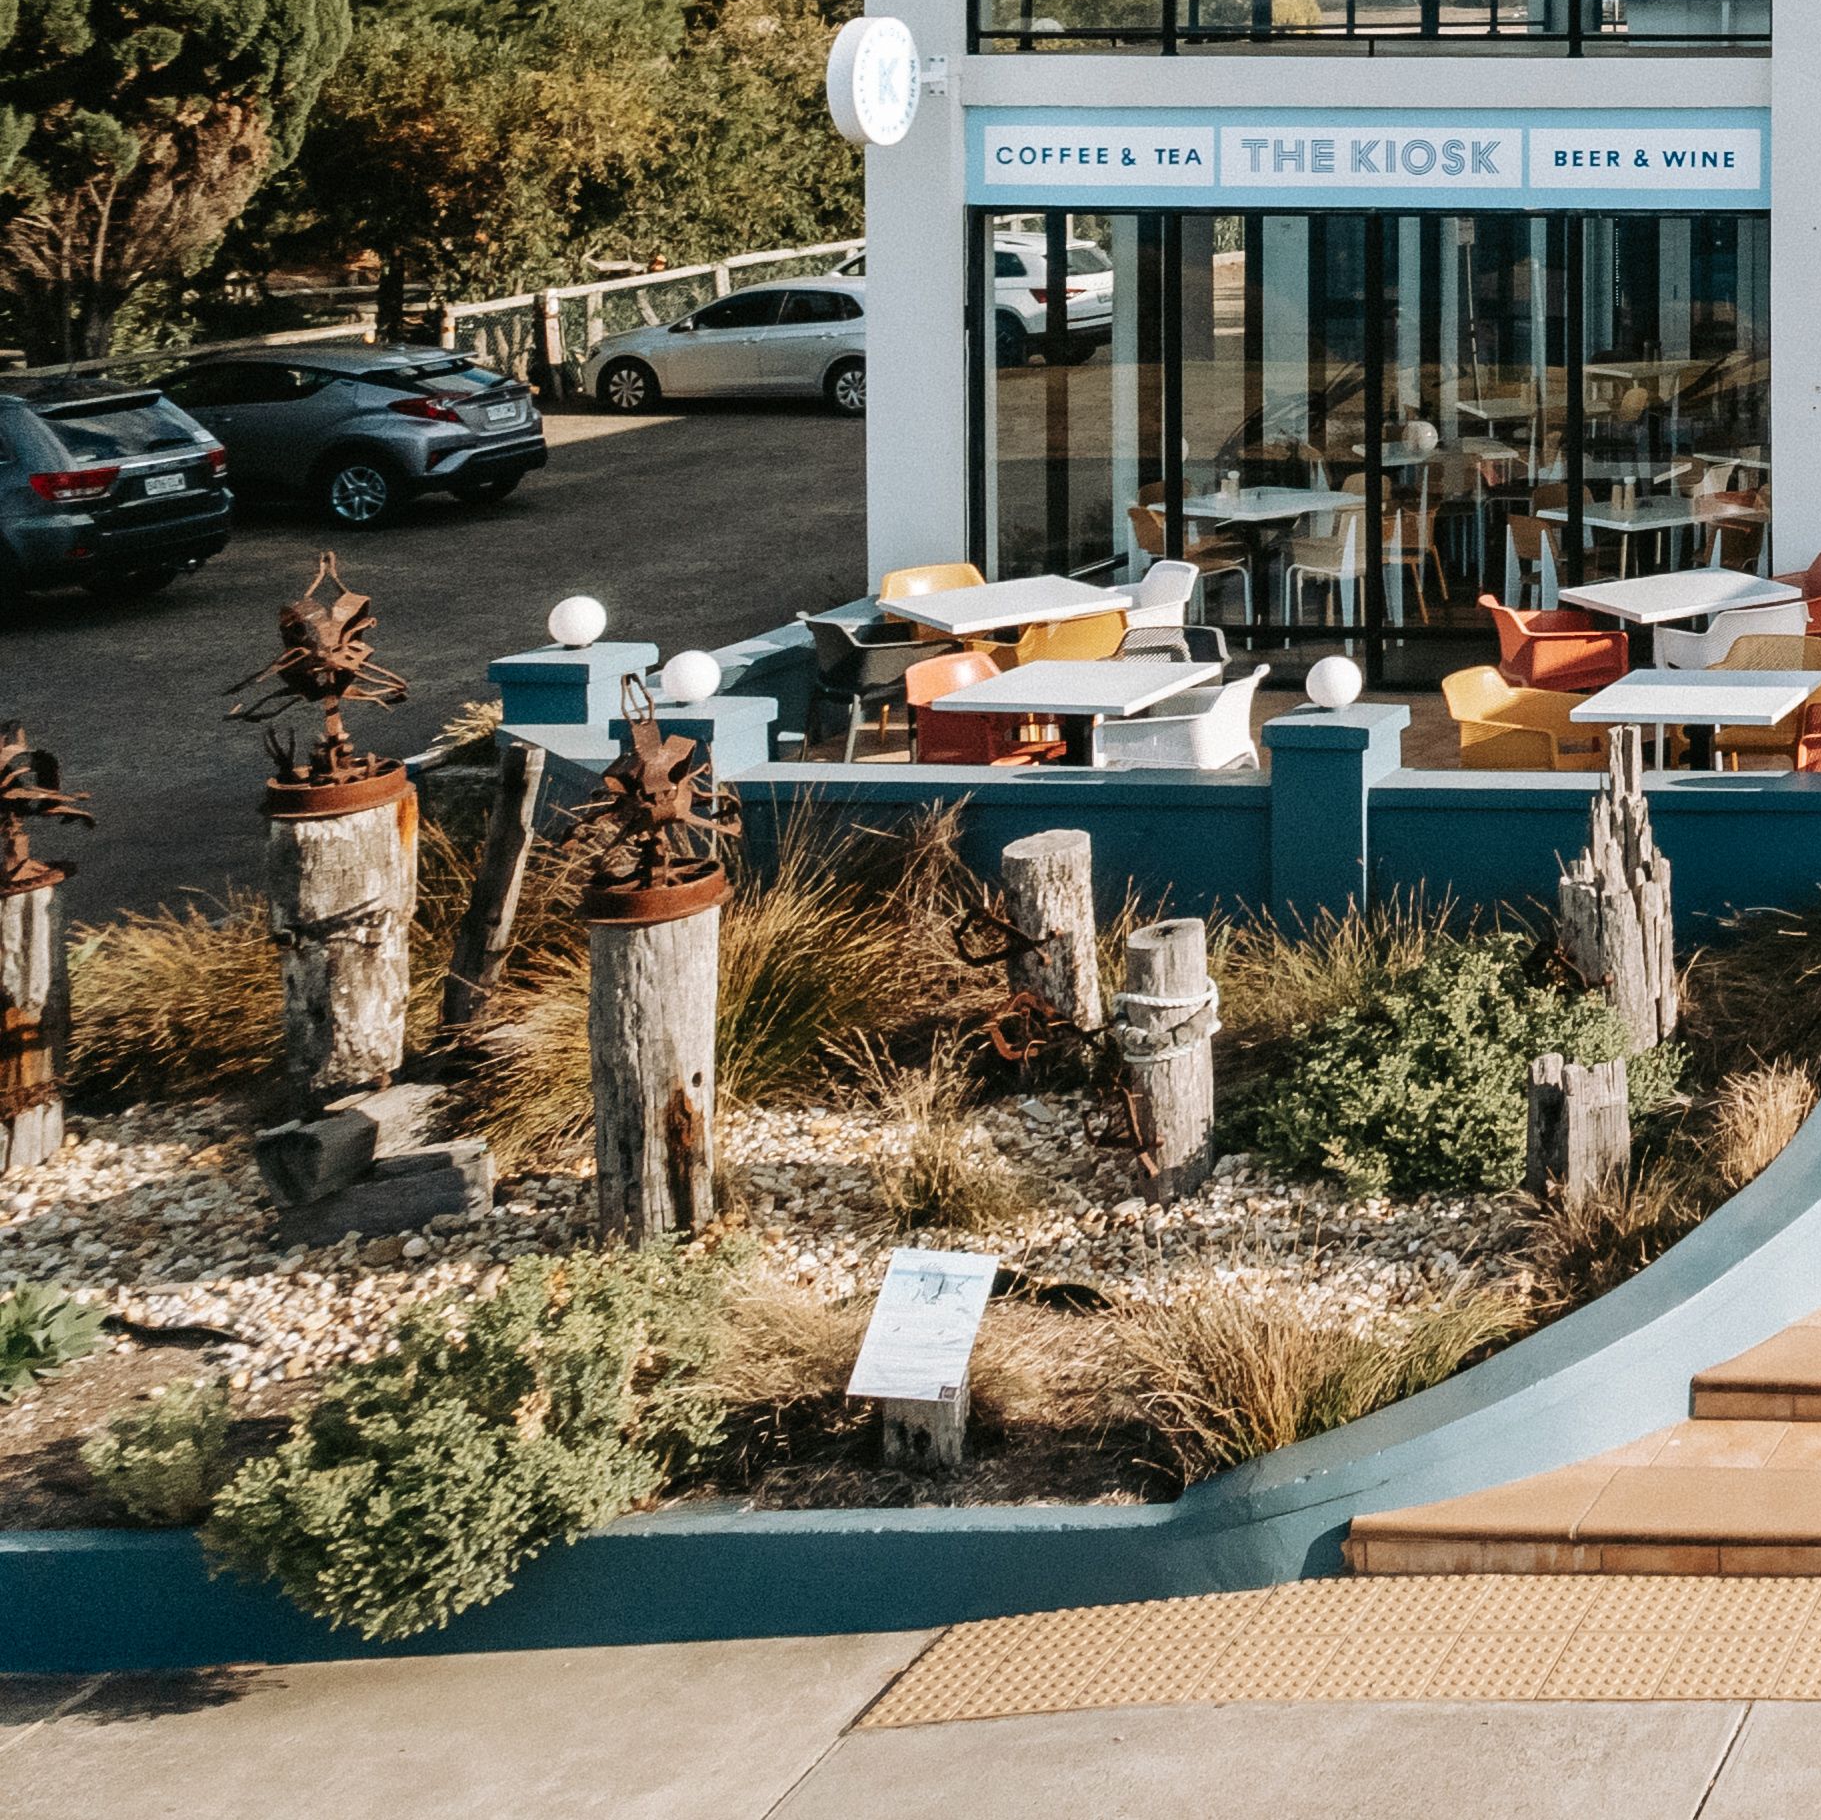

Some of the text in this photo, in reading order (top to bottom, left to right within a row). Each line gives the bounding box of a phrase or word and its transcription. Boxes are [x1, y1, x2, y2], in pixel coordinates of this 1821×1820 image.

[995, 145, 1203, 167] COFFEE & TEA
[1241, 138, 1502, 177] THE KIOSK
[1553, 148, 1736, 169] BEER & WINE
